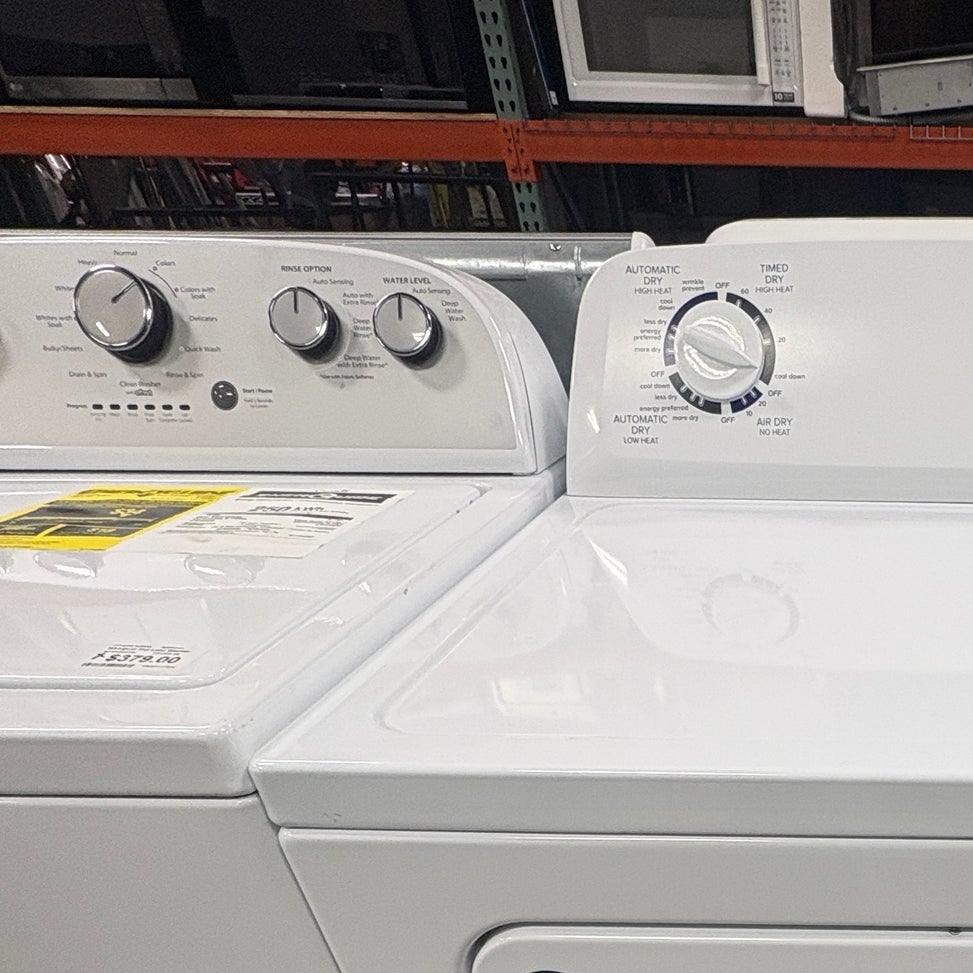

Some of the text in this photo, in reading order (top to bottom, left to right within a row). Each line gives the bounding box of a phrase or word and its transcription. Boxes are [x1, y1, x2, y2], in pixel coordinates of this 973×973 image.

[280, 265, 332, 273] RINSE OPTION
[625, 265, 681, 274] AUTOMATIC
[760, 264, 789, 273] TIMED
[329, 278, 354, 286] Sensing
[643, 277, 662, 285] DRY
[765, 275, 784, 284] DRY
[120, 380, 139, 388] Clean
[613, 414, 668, 424] AUTOMATIC
[756, 418, 793, 426] AIR DRY
[631, 426, 650, 435] DRY
[105, 654, 182, 664] $379.00
